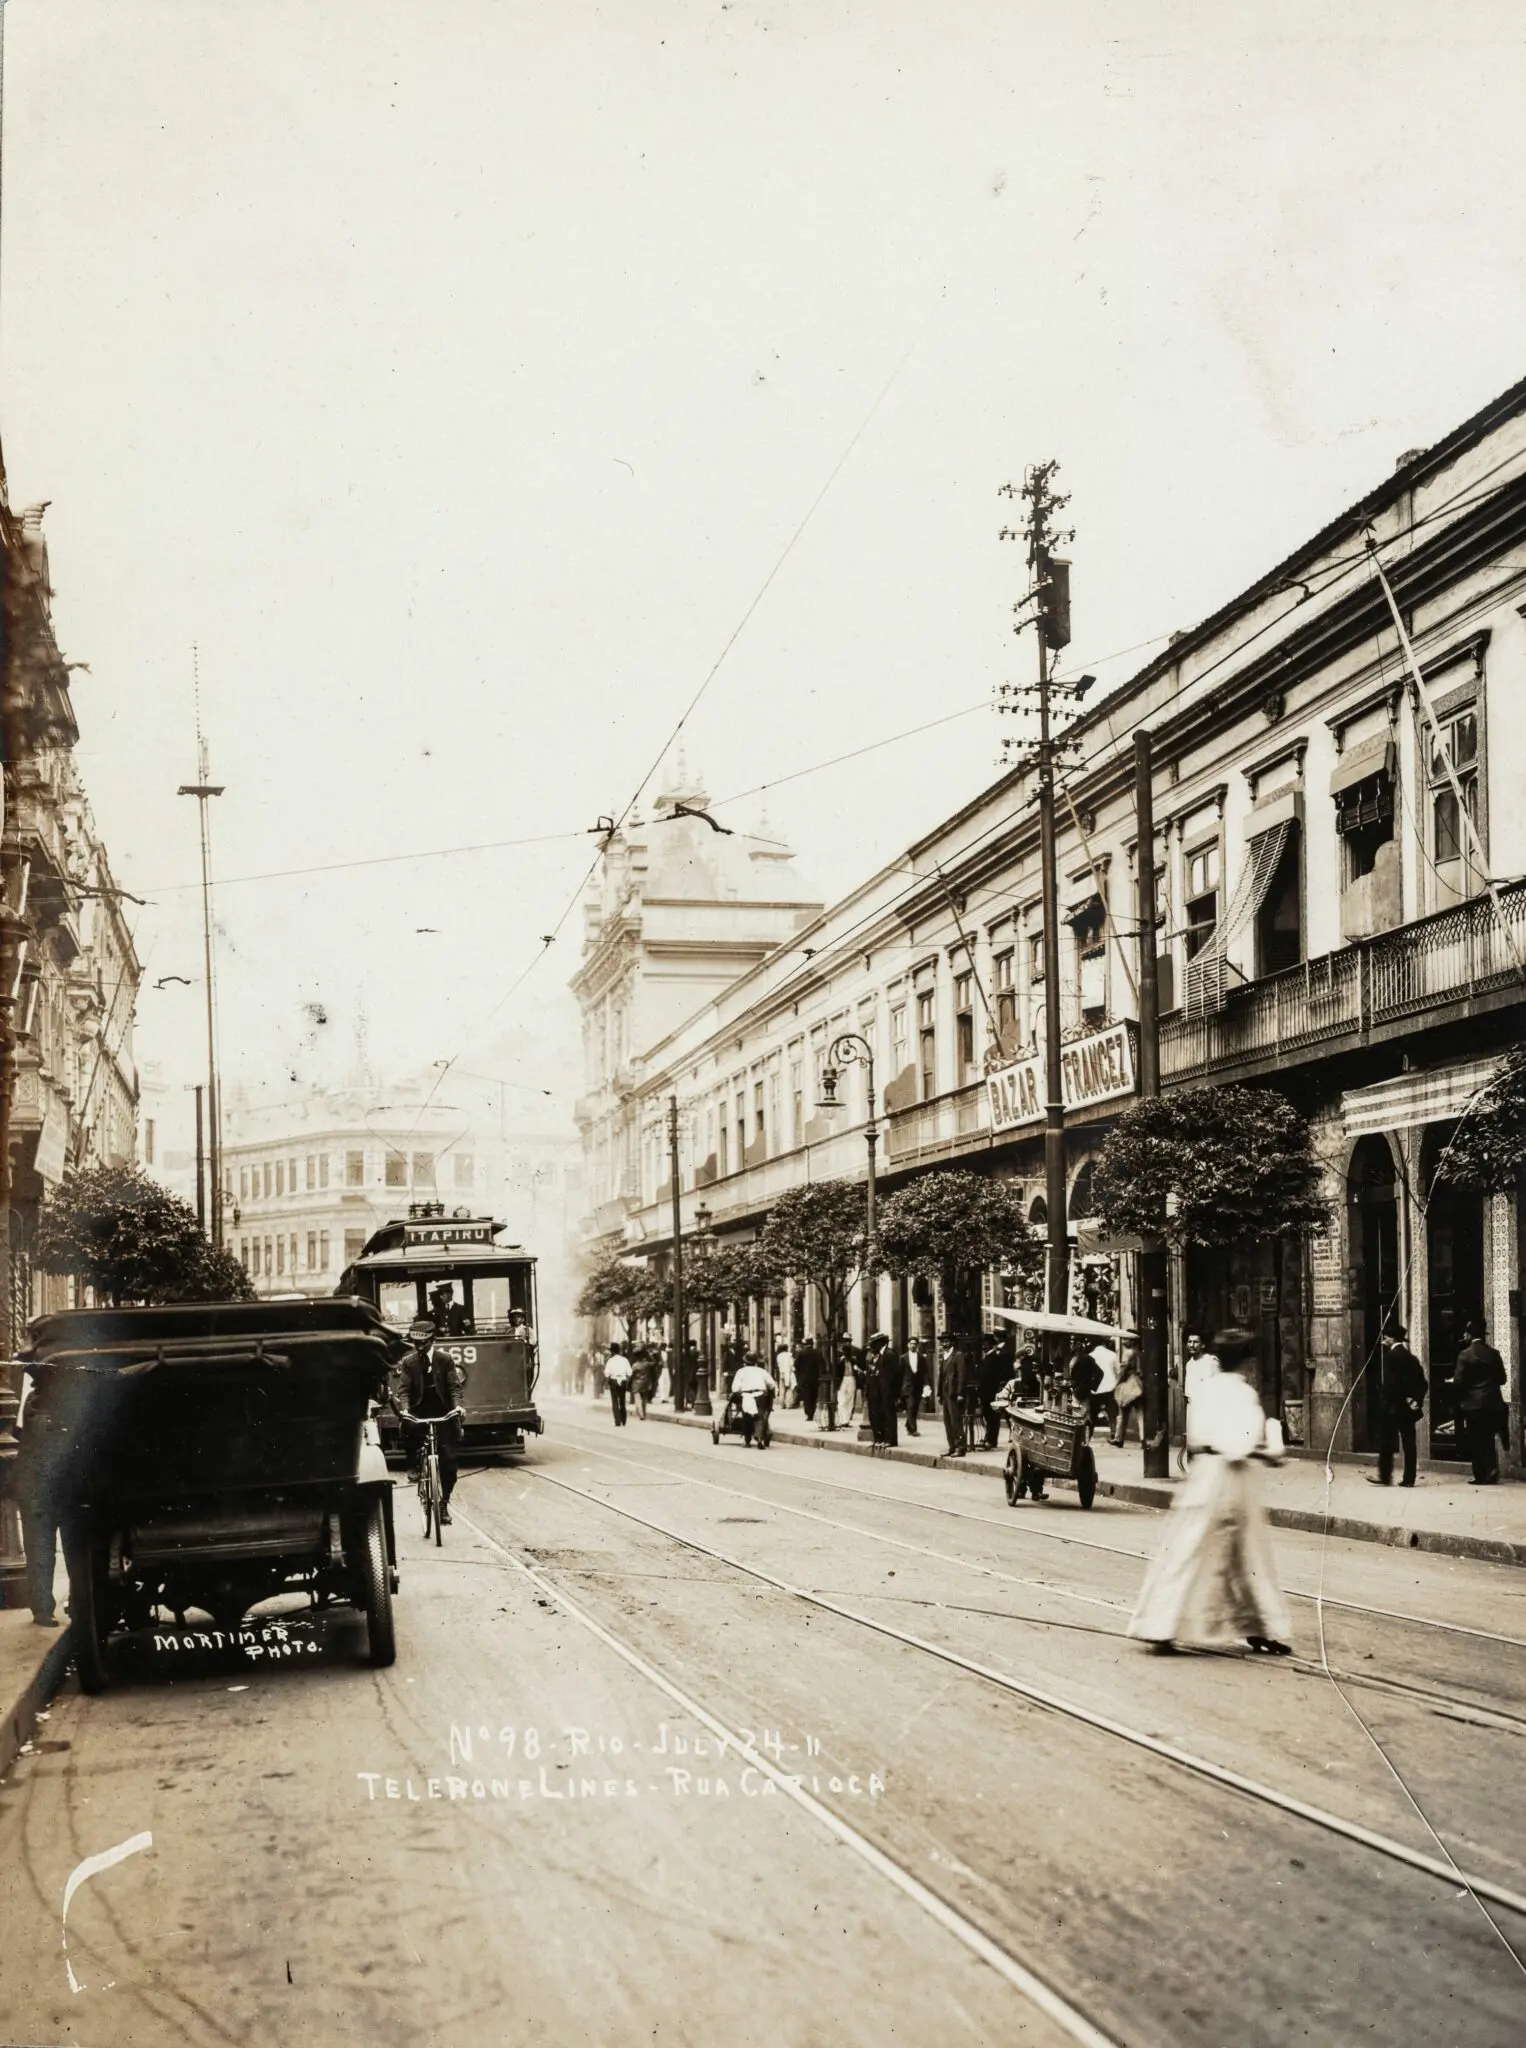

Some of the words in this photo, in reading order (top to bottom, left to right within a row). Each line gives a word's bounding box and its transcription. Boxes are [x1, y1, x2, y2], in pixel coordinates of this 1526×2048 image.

[990, 1066, 1040, 1126] BAZAR
[1062, 1032, 1131, 1104] FRANCEZ
[410, 1228, 485, 1242] ITAPIRU
[436, 1346, 477, 1364] 69
